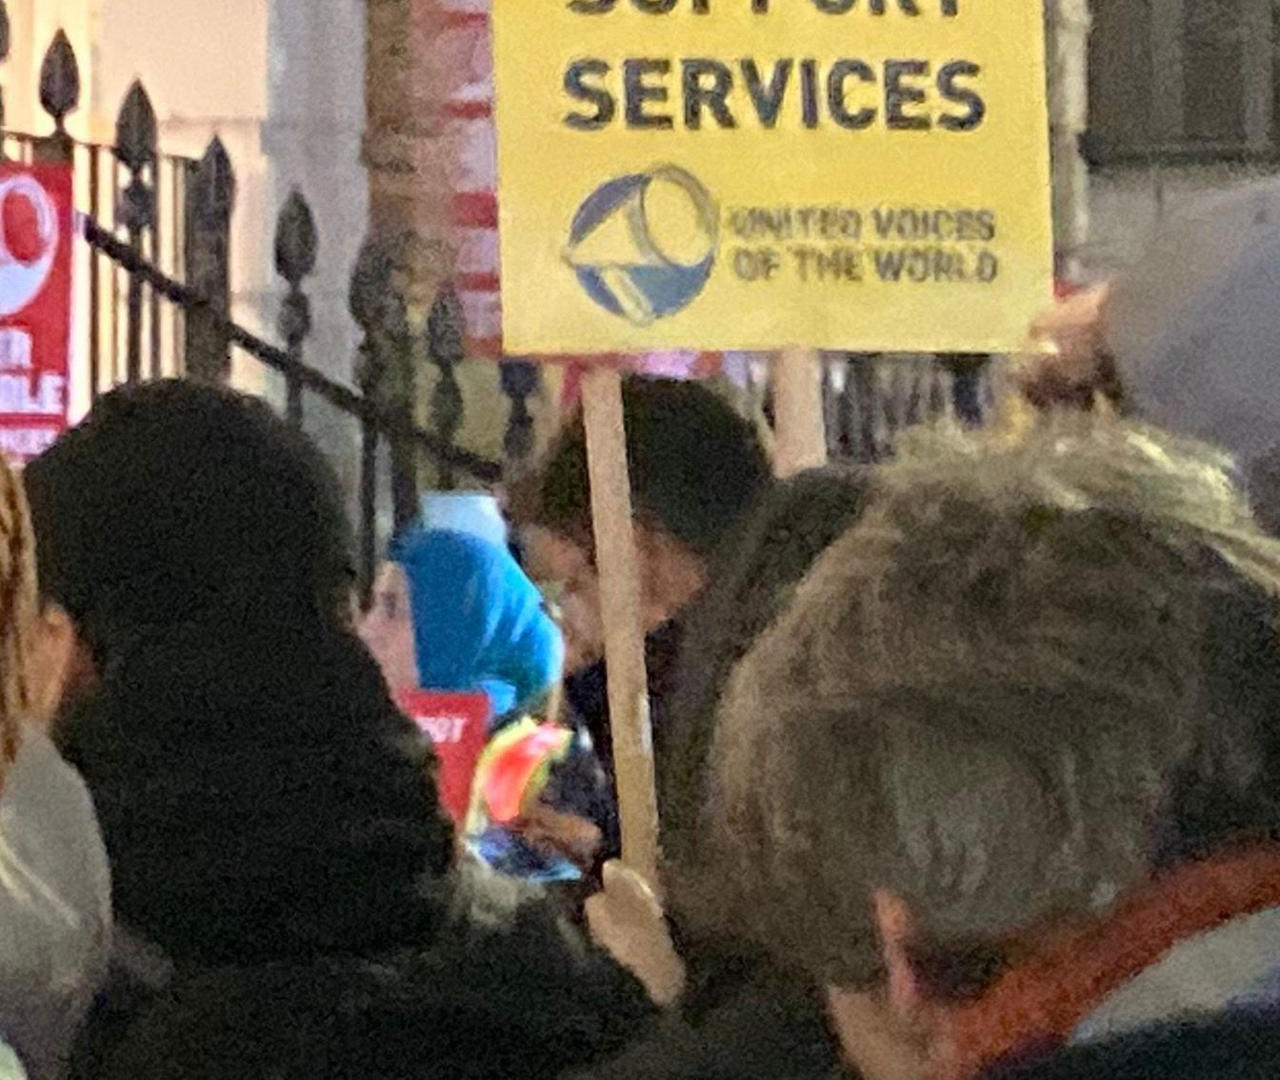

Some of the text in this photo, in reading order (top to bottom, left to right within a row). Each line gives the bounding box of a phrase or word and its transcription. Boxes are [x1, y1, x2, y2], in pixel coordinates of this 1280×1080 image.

[562, 57, 986, 131] SERVICES
[728, 205, 995, 240] UNITED VOICES
[734, 247, 998, 283] OF THE WORLD
